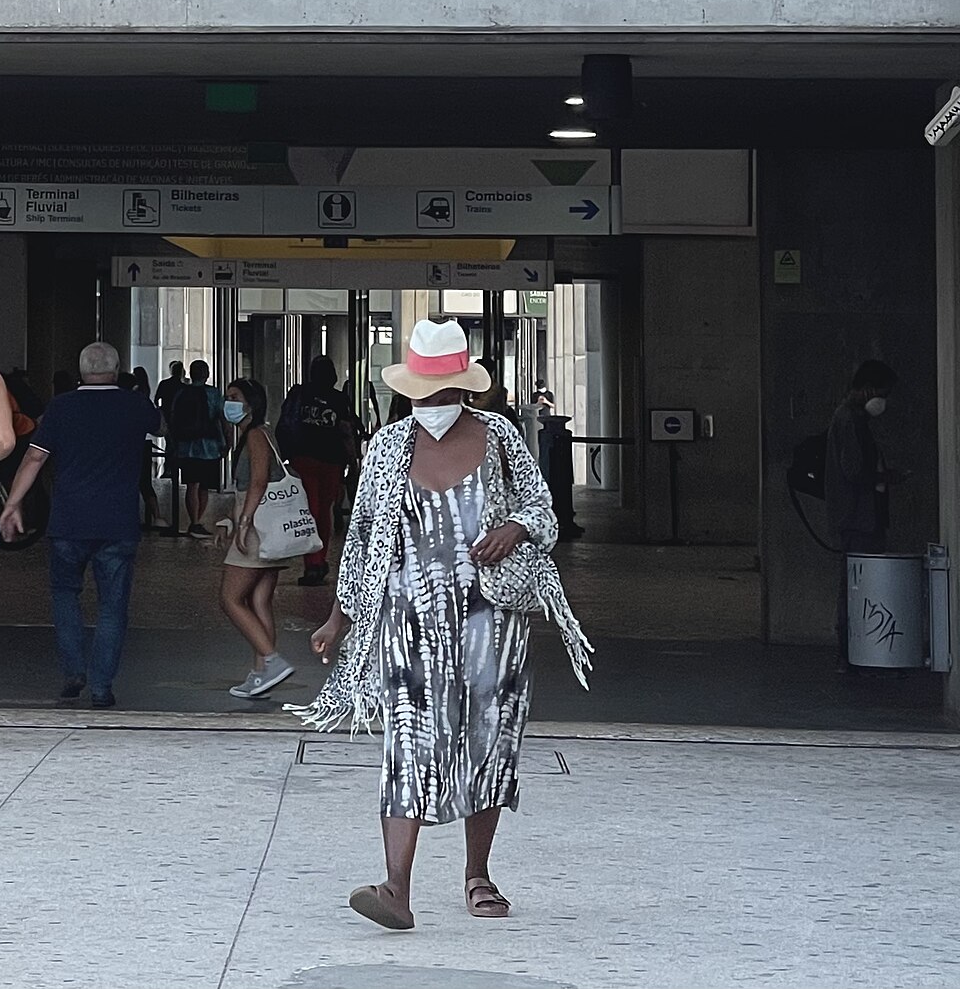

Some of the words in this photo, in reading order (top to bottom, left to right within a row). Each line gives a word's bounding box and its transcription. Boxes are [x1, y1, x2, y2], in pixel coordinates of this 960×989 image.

[58, 158, 107, 169] CONSULTAS
[109, 158, 120, 169] DE
[25, 188, 79, 200] Terminal
[171, 189, 240, 202] Bilheteiras
[465, 190, 533, 202] Comboios
[25, 201, 67, 213] Fluvial
[171, 204, 202, 212] Tickets
[465, 205, 492, 213] Trains
[26, 214, 46, 224] Ship
[48, 214, 84, 223] Terminal
[243, 261, 277, 269] Terminal
[283, 516, 314, 533] plastic
[294, 527, 316, 538] bags
